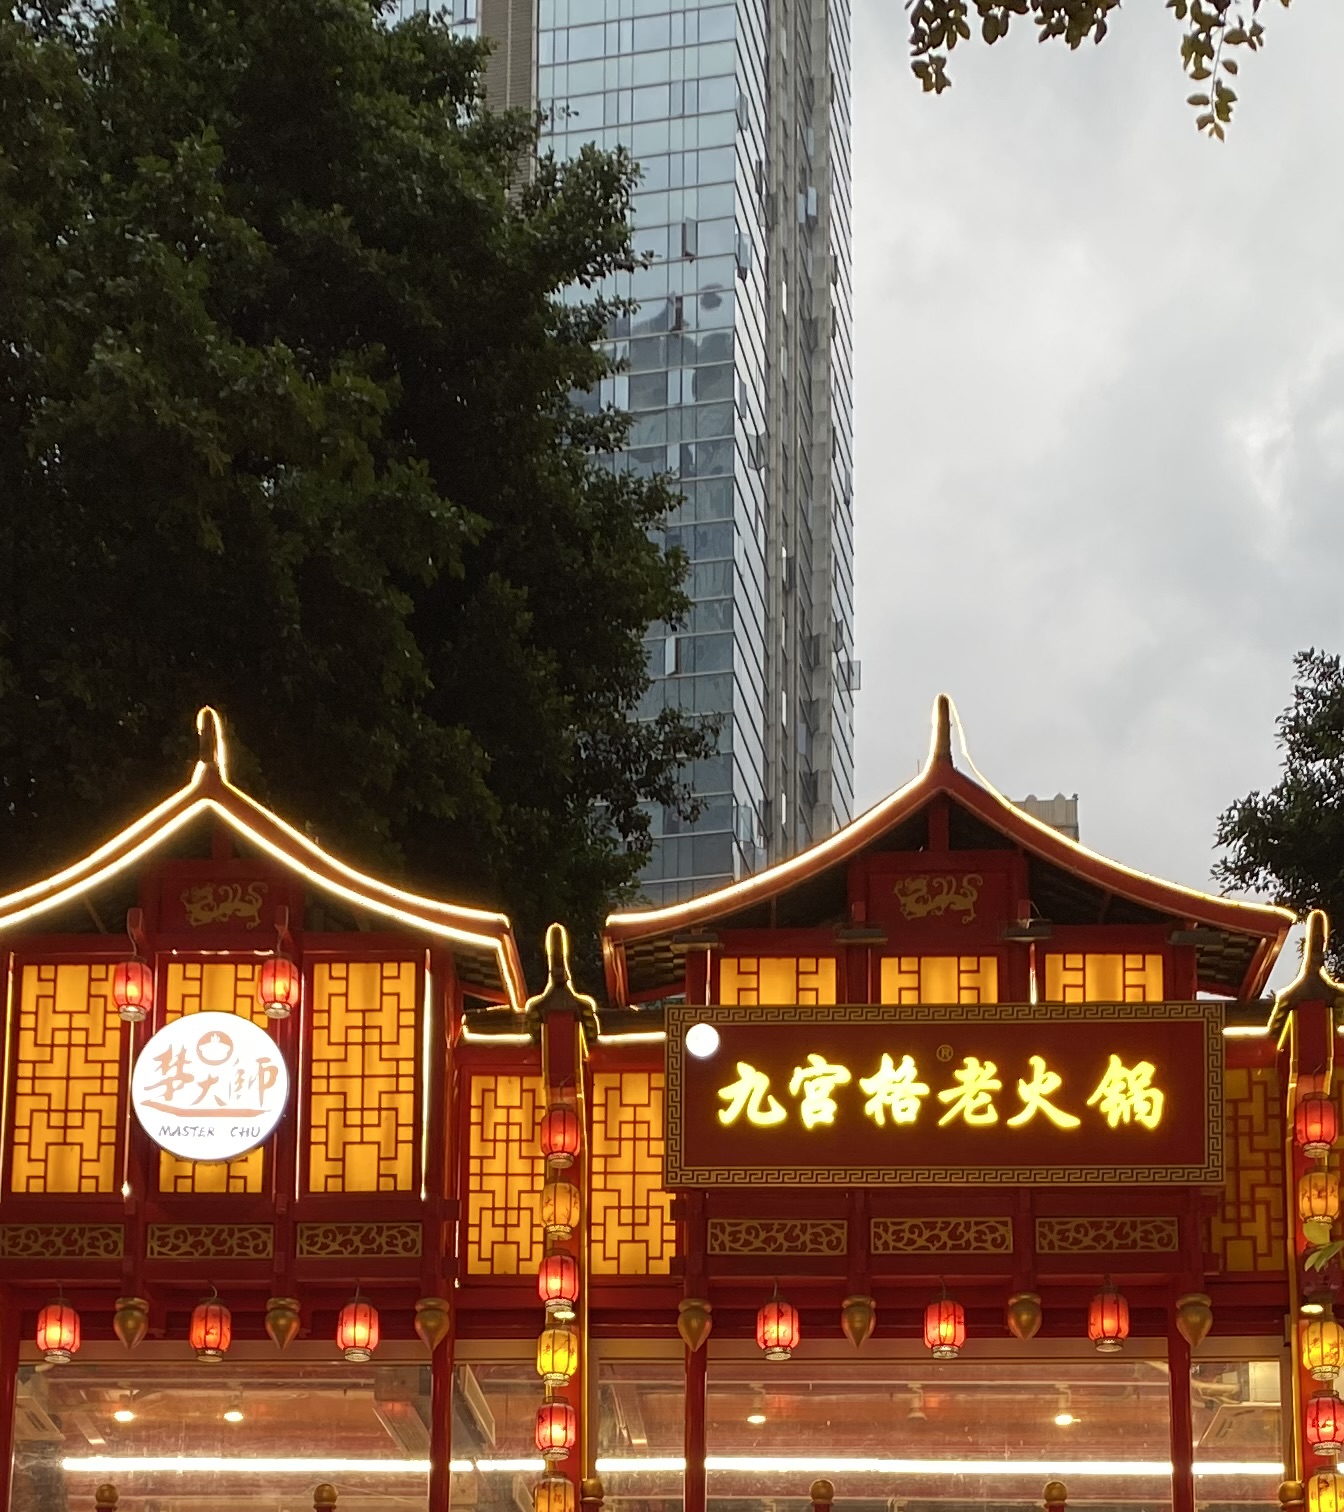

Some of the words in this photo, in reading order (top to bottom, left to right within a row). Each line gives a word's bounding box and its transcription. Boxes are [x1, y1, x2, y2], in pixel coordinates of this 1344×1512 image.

[717, 1053, 1165, 1130] 九宫格老火锅
[158, 1126, 215, 1138] MASTER
[230, 1126, 261, 1138] CHU
